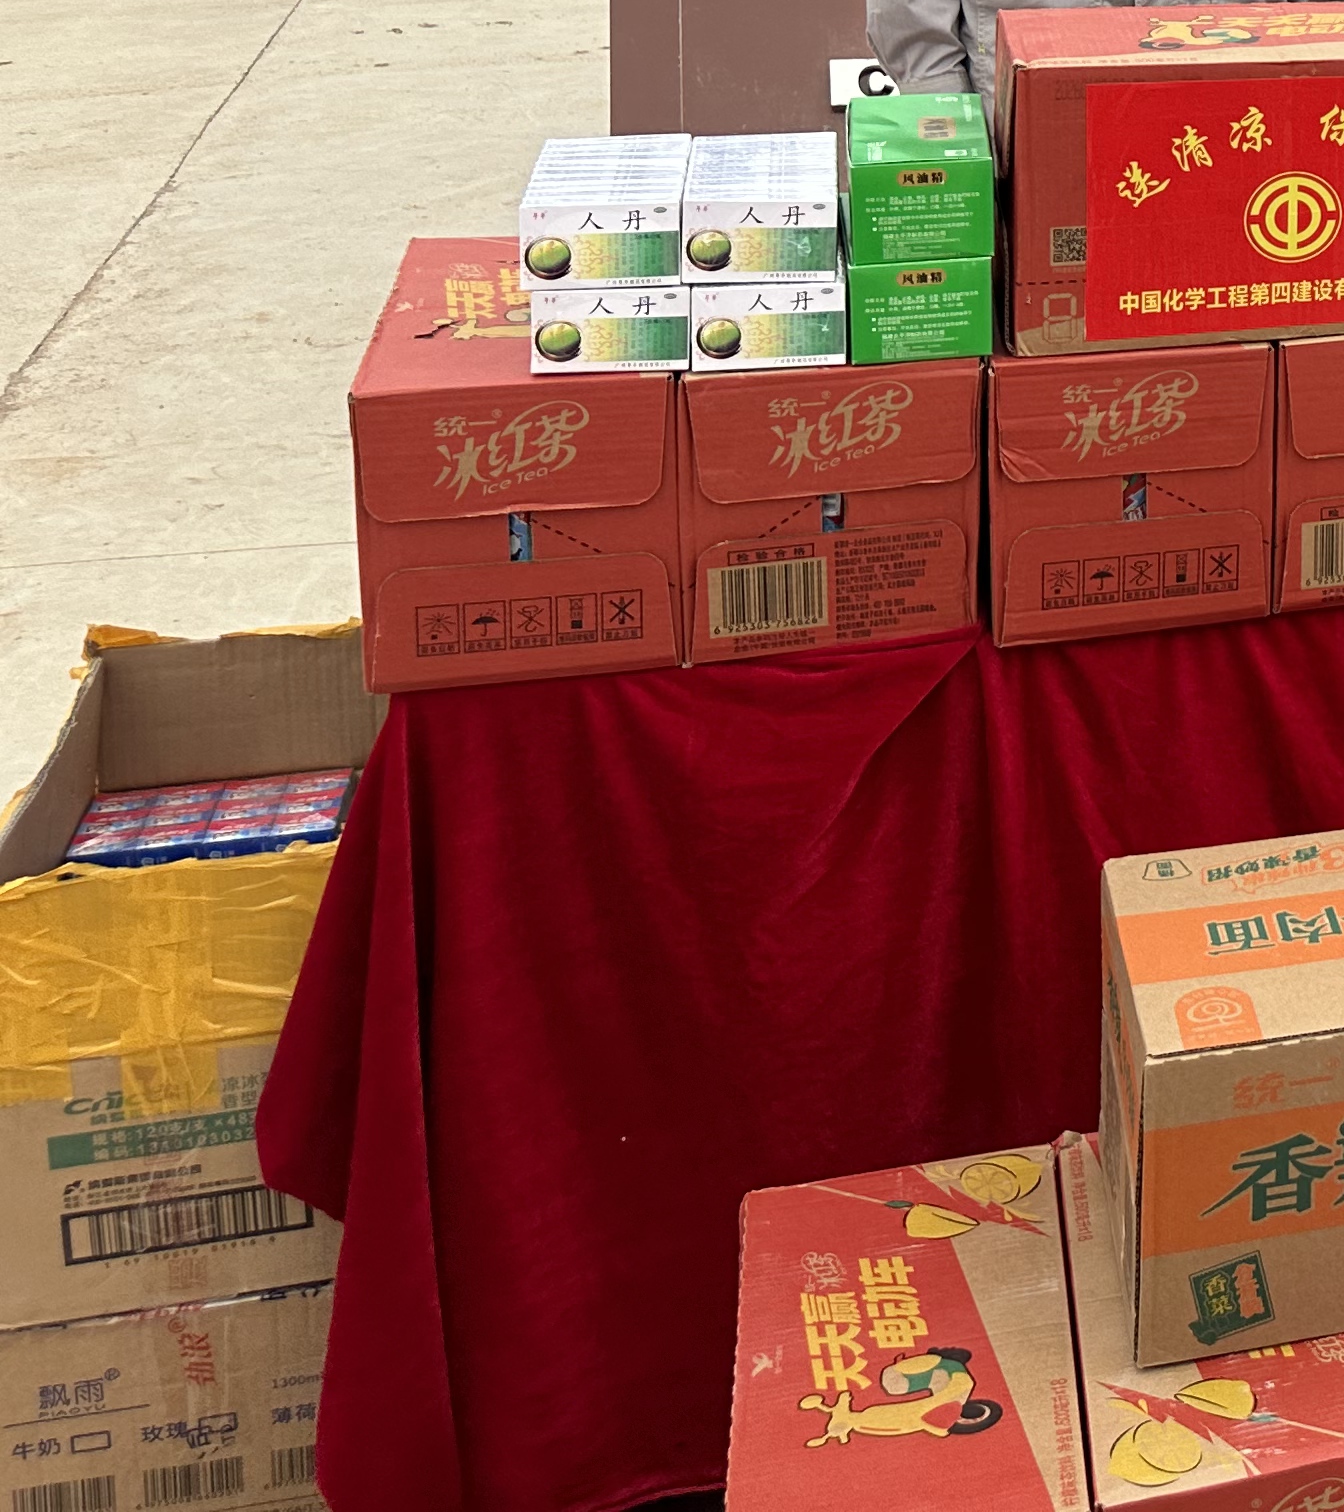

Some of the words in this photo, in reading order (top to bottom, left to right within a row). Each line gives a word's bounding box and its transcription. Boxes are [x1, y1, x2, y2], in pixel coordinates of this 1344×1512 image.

[1116, 106, 1272, 208] 送清凉
[902, 172, 944, 185] 风油精
[578, 209, 646, 231] 人丹
[739, 206, 806, 226] 人丹
[901, 270, 943, 285] 风油精
[589, 295, 657, 316] 人丹
[748, 290, 814, 312] 人丹
[1062, 383, 1118, 404] 统一
[768, 396, 828, 419] 统一
[1062, 369, 1200, 458] 冰红茶
[434, 415, 496, 437] 统一
[769, 381, 914, 478] 冰红茶
[433, 400, 590, 502] 冰红茶
[736, 548, 806, 562] 检验合格
[1233, 1070, 1333, 1109] 统一
[859, 1255, 930, 1349] 电动车
[1204, 1272, 1233, 1316] 香菜
[800, 1291, 872, 1391] 天天赢
[39, 1377, 105, 1408] 飘雨
[39, 1404, 106, 1419] PIAOYU
[271, 1402, 317, 1426] 薄荷
[141, 1420, 188, 1443] 玫瑰
[12, 1437, 61, 1460] 牛奶
